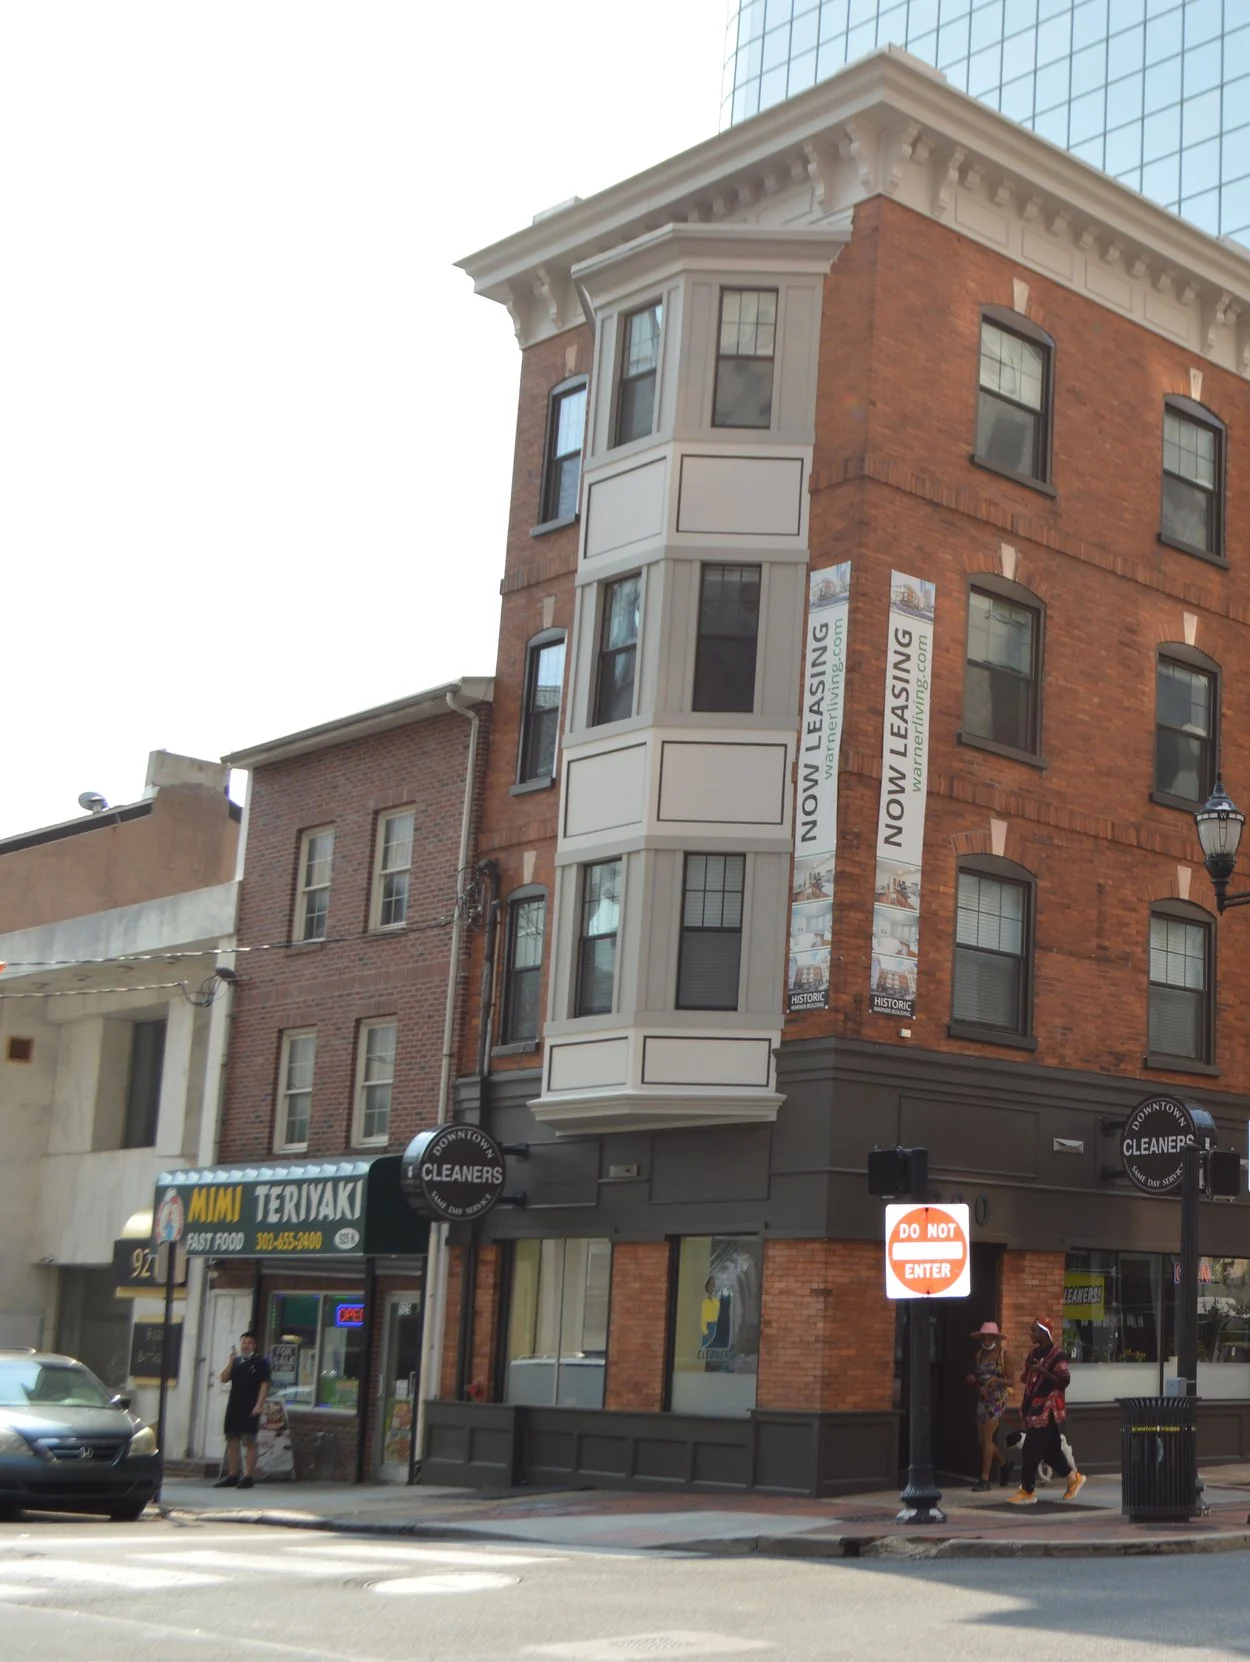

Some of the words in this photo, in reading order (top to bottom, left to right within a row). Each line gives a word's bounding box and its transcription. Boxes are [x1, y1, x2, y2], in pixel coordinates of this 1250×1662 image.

[805, 622, 829, 752] LEASING
[825, 618, 844, 780] warnerliving.com
[889, 628, 913, 758] LEASING
[912, 634, 929, 793] warnerliving.com
[801, 763, 819, 842] NOW
[884, 765, 906, 847] NOW
[791, 991, 825, 1004] HISTORIC
[874, 996, 911, 1011] HISTORIC
[1131, 1101, 1187, 1131] DOWNTOWN
[432, 1130, 494, 1158] DOWNTOWN
[422, 1163, 503, 1184] CLEANERS
[1131, 1164, 1147, 1183] SAME
[1147, 1177, 1162, 1188] DAY
[187, 1185, 244, 1223] MIMI
[255, 1179, 364, 1224] TERIYAKI
[431, 1190, 447, 1209] SAME
[448, 1205, 464, 1216] DAY
[186, 1232, 212, 1251] FAST
[214, 1231, 246, 1251] FOOD
[900, 1223, 921, 1239] DO
[927, 1223, 956, 1238] NOT
[904, 1262, 951, 1279] ENTER
